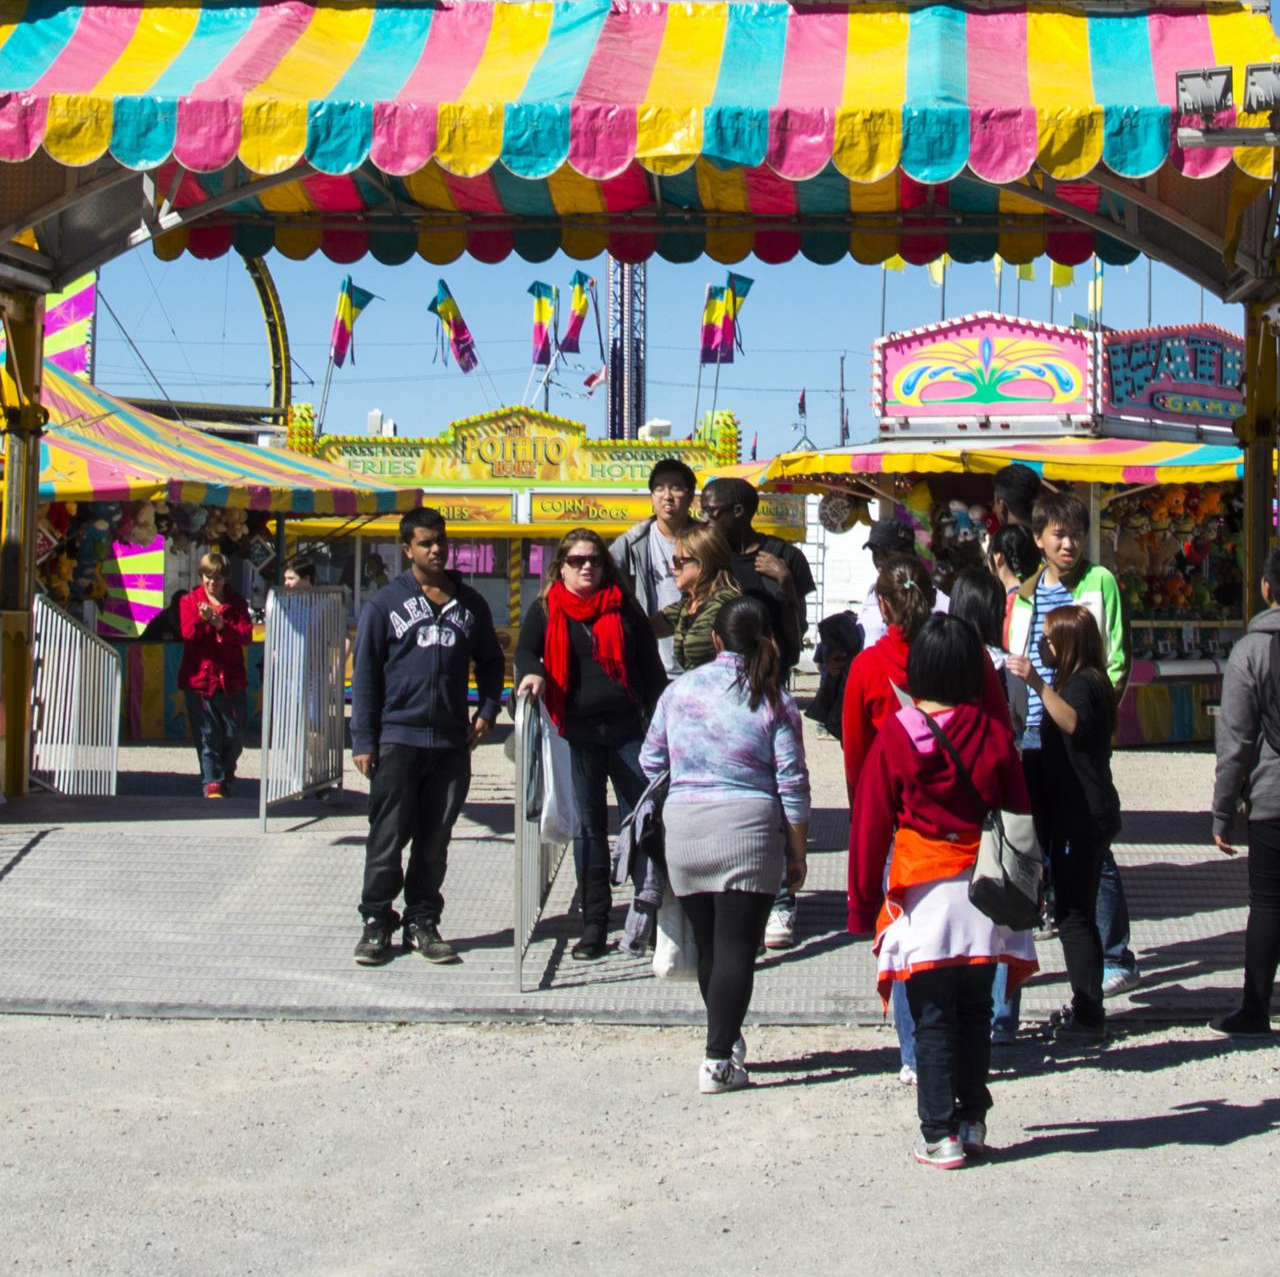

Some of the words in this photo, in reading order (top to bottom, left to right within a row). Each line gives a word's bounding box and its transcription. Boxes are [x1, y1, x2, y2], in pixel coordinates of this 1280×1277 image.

[460, 432, 569, 465] POTATO
[347, 459, 418, 475] FRIES
[492, 460, 537, 477] HOUSE
[439, 506, 470, 520] RIES
[541, 498, 585, 513] CORN
[588, 505, 629, 520] DOGS
